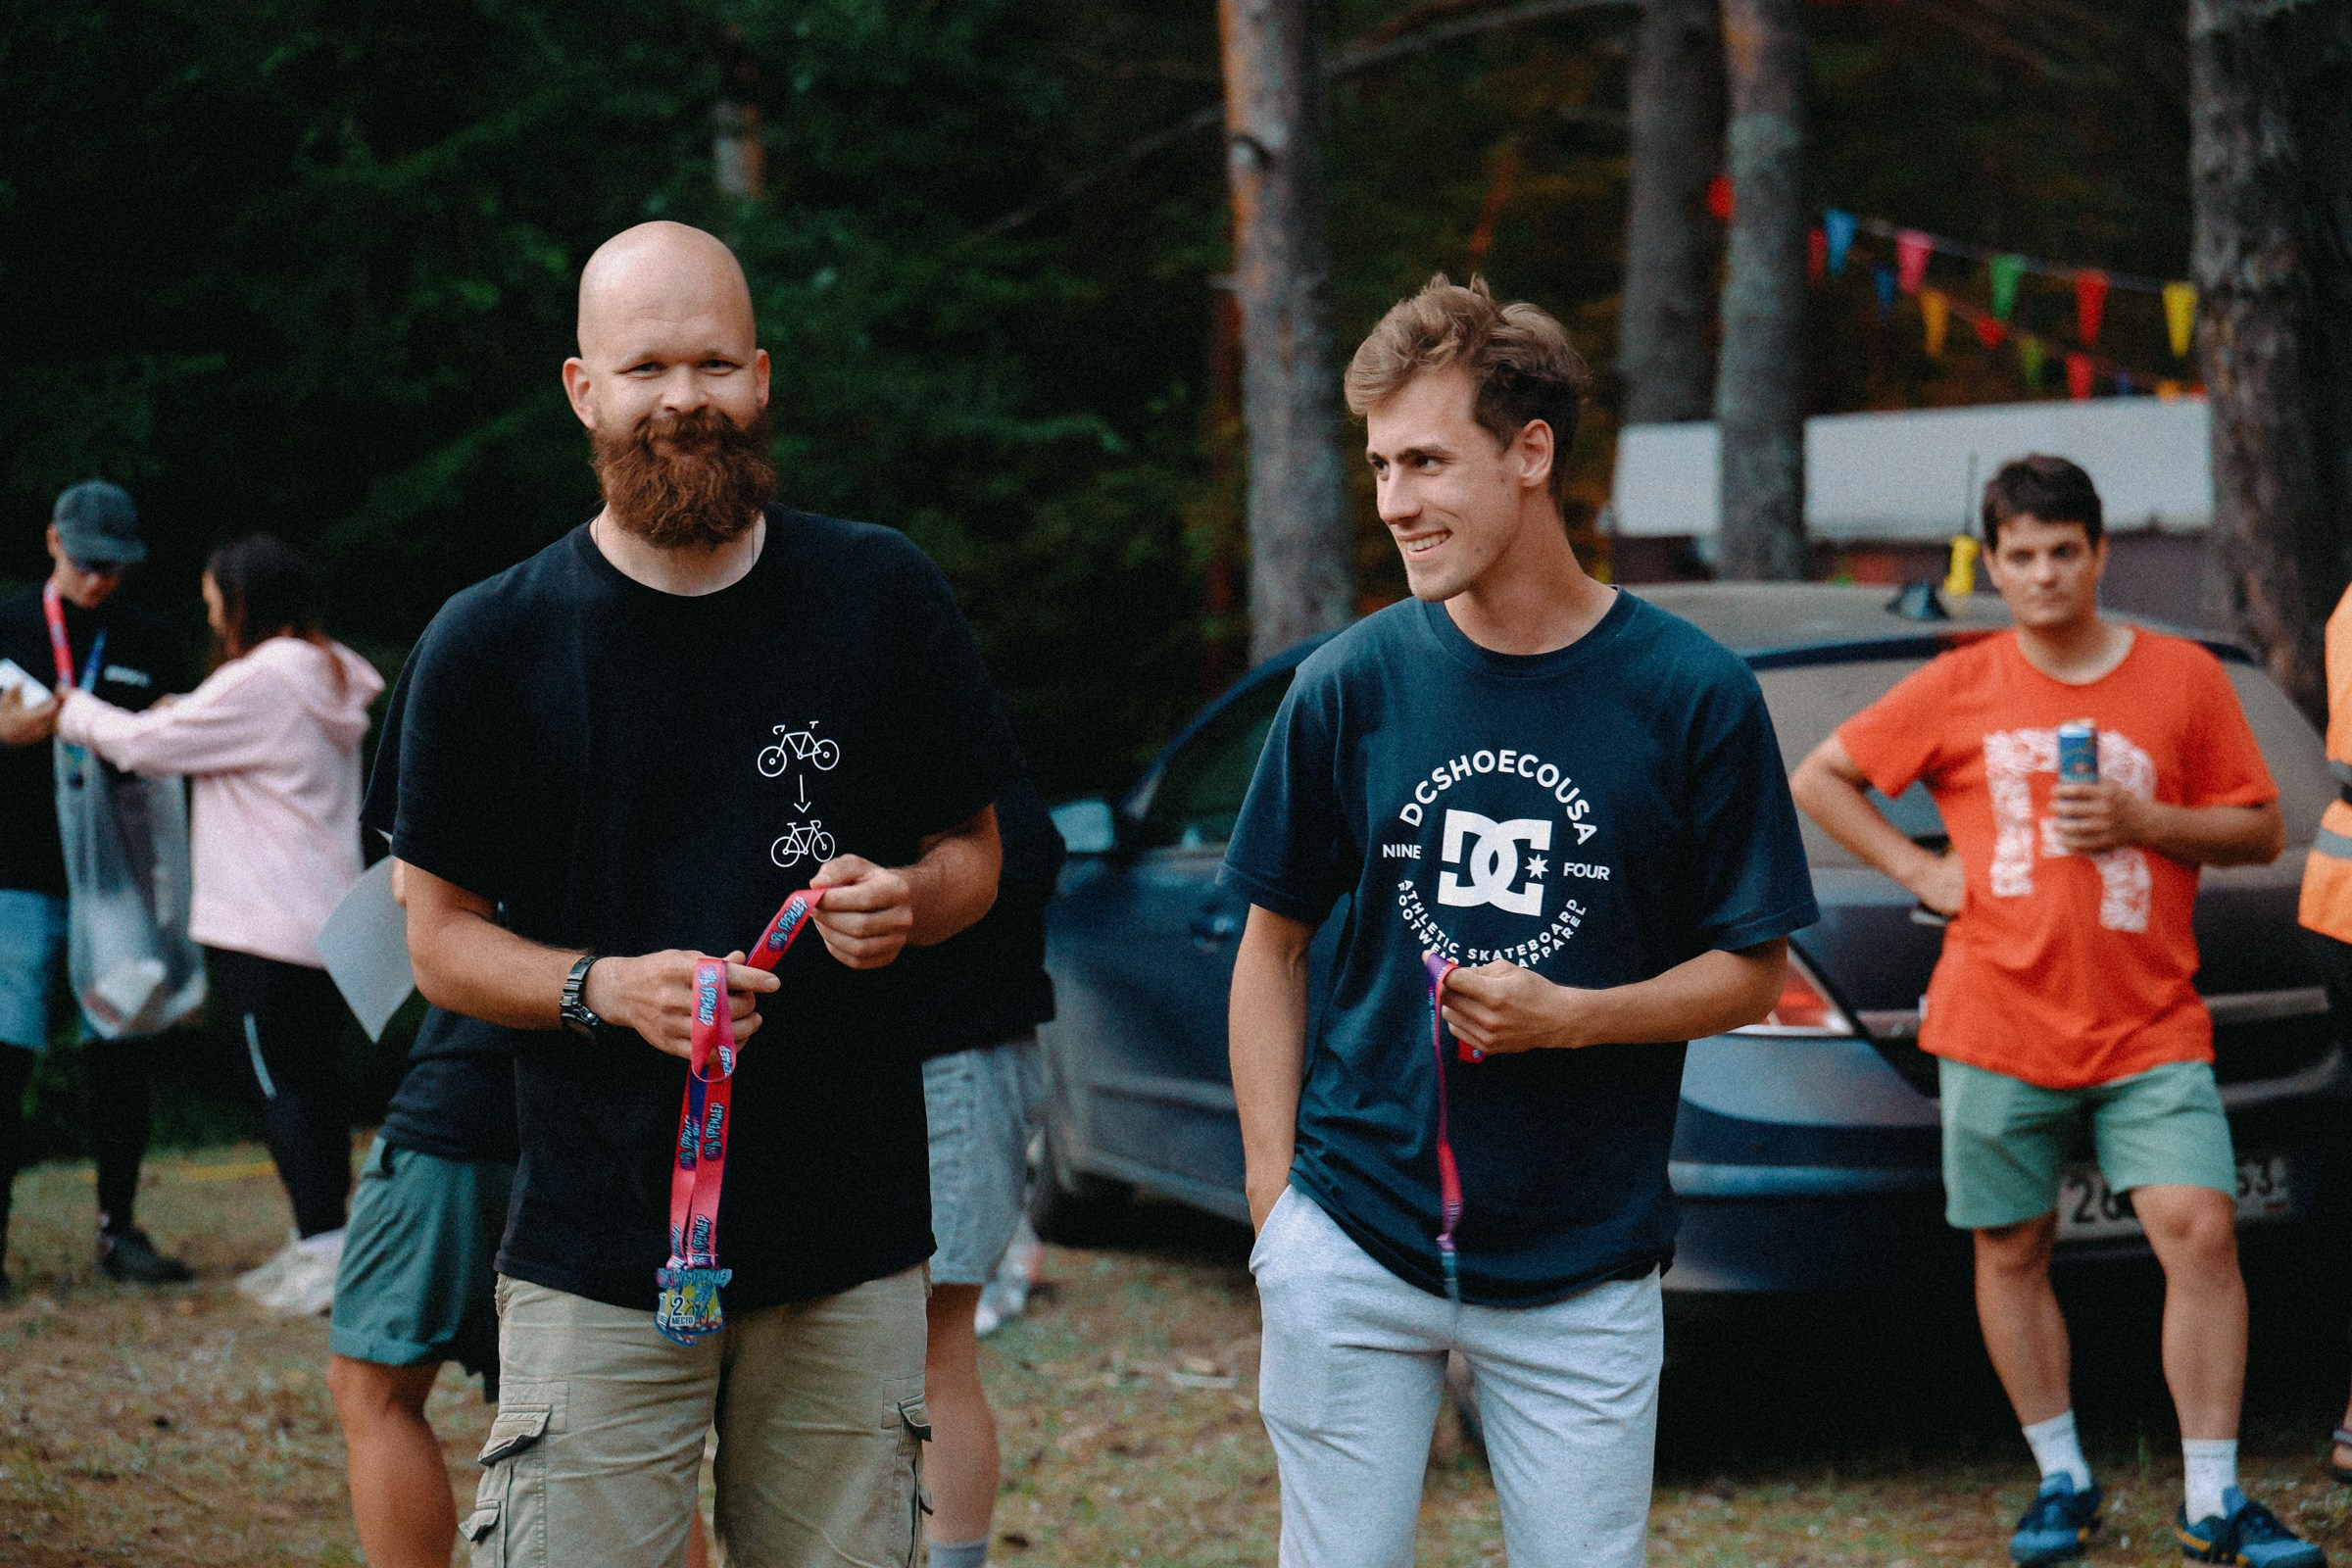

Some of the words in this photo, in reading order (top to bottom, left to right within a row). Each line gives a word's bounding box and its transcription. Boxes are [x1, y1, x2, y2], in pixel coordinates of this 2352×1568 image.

[1399, 749, 1597, 845] DCSHOECOUSA
[1383, 844, 1422, 859] NINE
[1563, 862, 1610, 880] FOUR
[1438, 808, 1552, 916] DC
[1404, 879, 1460, 954] ATHLETIC
[1467, 899, 1578, 961] SKATEBOARD
[1518, 907, 1587, 968] APPAREL
[671, 1316, 694, 1325] МЕСТО
[672, 1297, 684, 1316] 2
